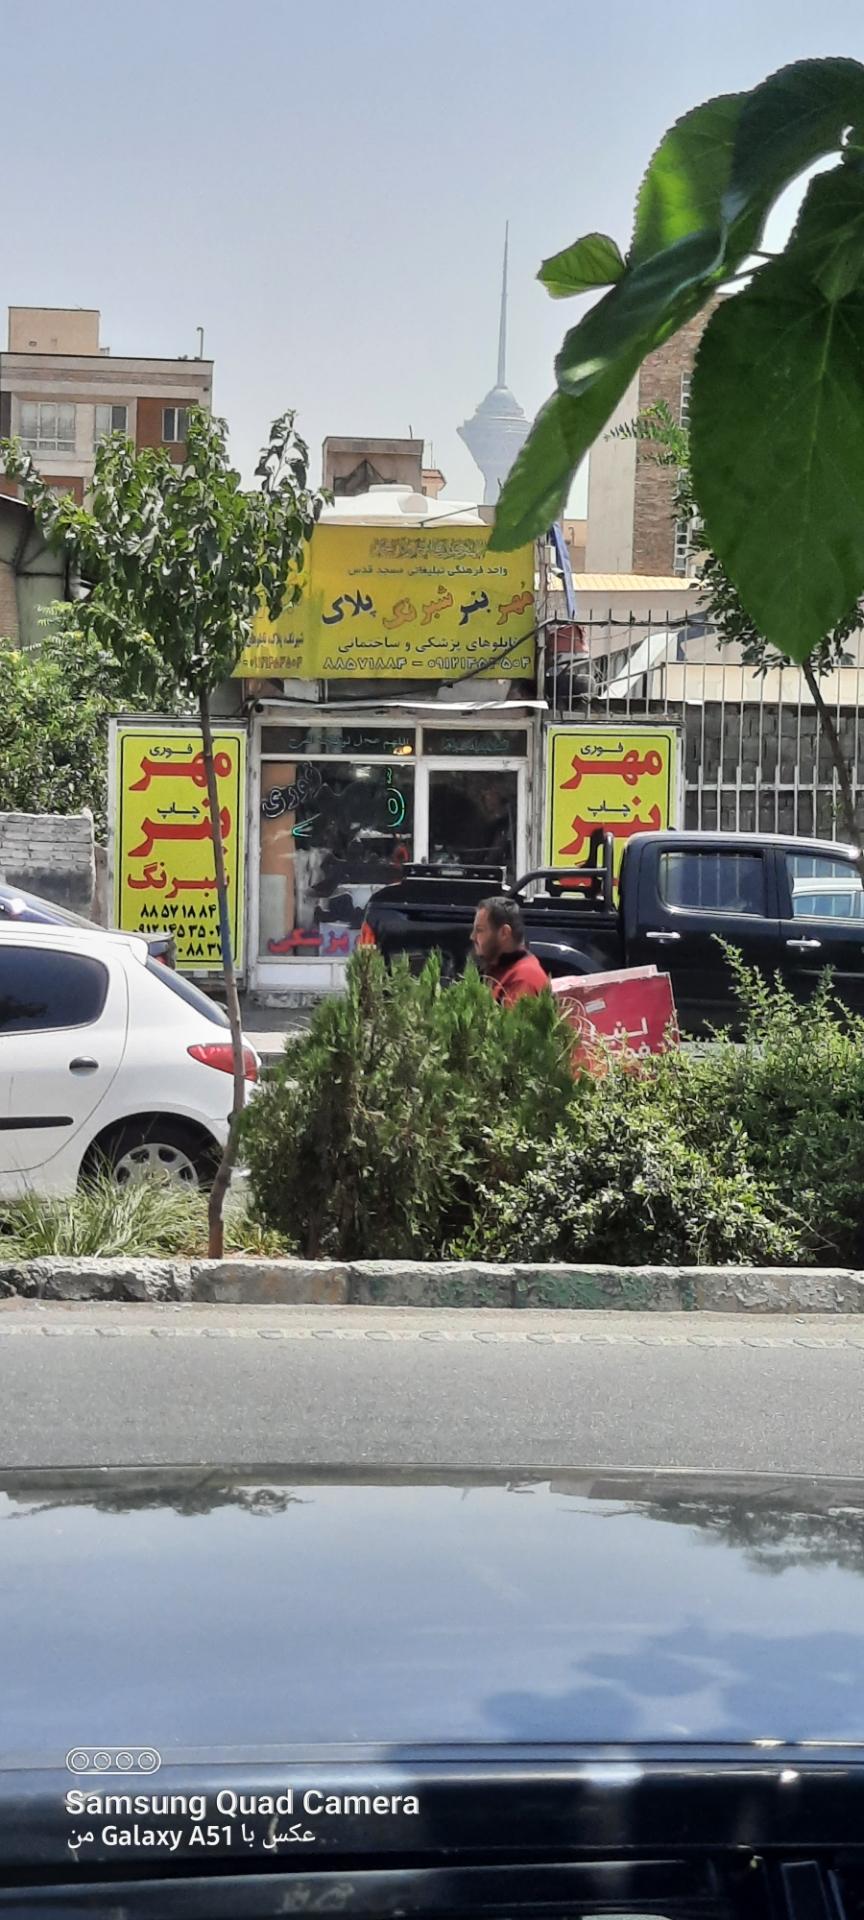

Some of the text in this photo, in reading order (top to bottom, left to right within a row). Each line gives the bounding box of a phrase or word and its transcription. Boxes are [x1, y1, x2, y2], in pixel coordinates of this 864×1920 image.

[348, 565, 508, 578] واحد فرهنگی تبلیغاتی مسجد قدس
[322, 589, 377, 625] پلاک
[458, 590, 491, 626] بنر
[337, 636, 400, 654] ساختمانی
[404, 641, 412, 652] و
[415, 636, 461, 654] پزشکی
[149, 743, 193, 758] فوری
[580, 742, 624, 757] فوری
[129, 752, 232, 791] مهر
[562, 750, 663, 790] مهر
[157, 802, 201, 819] چاپ
[587, 800, 631, 817] چاپ
[128, 797, 231, 857] بنر
[559, 796, 661, 855] بنر
